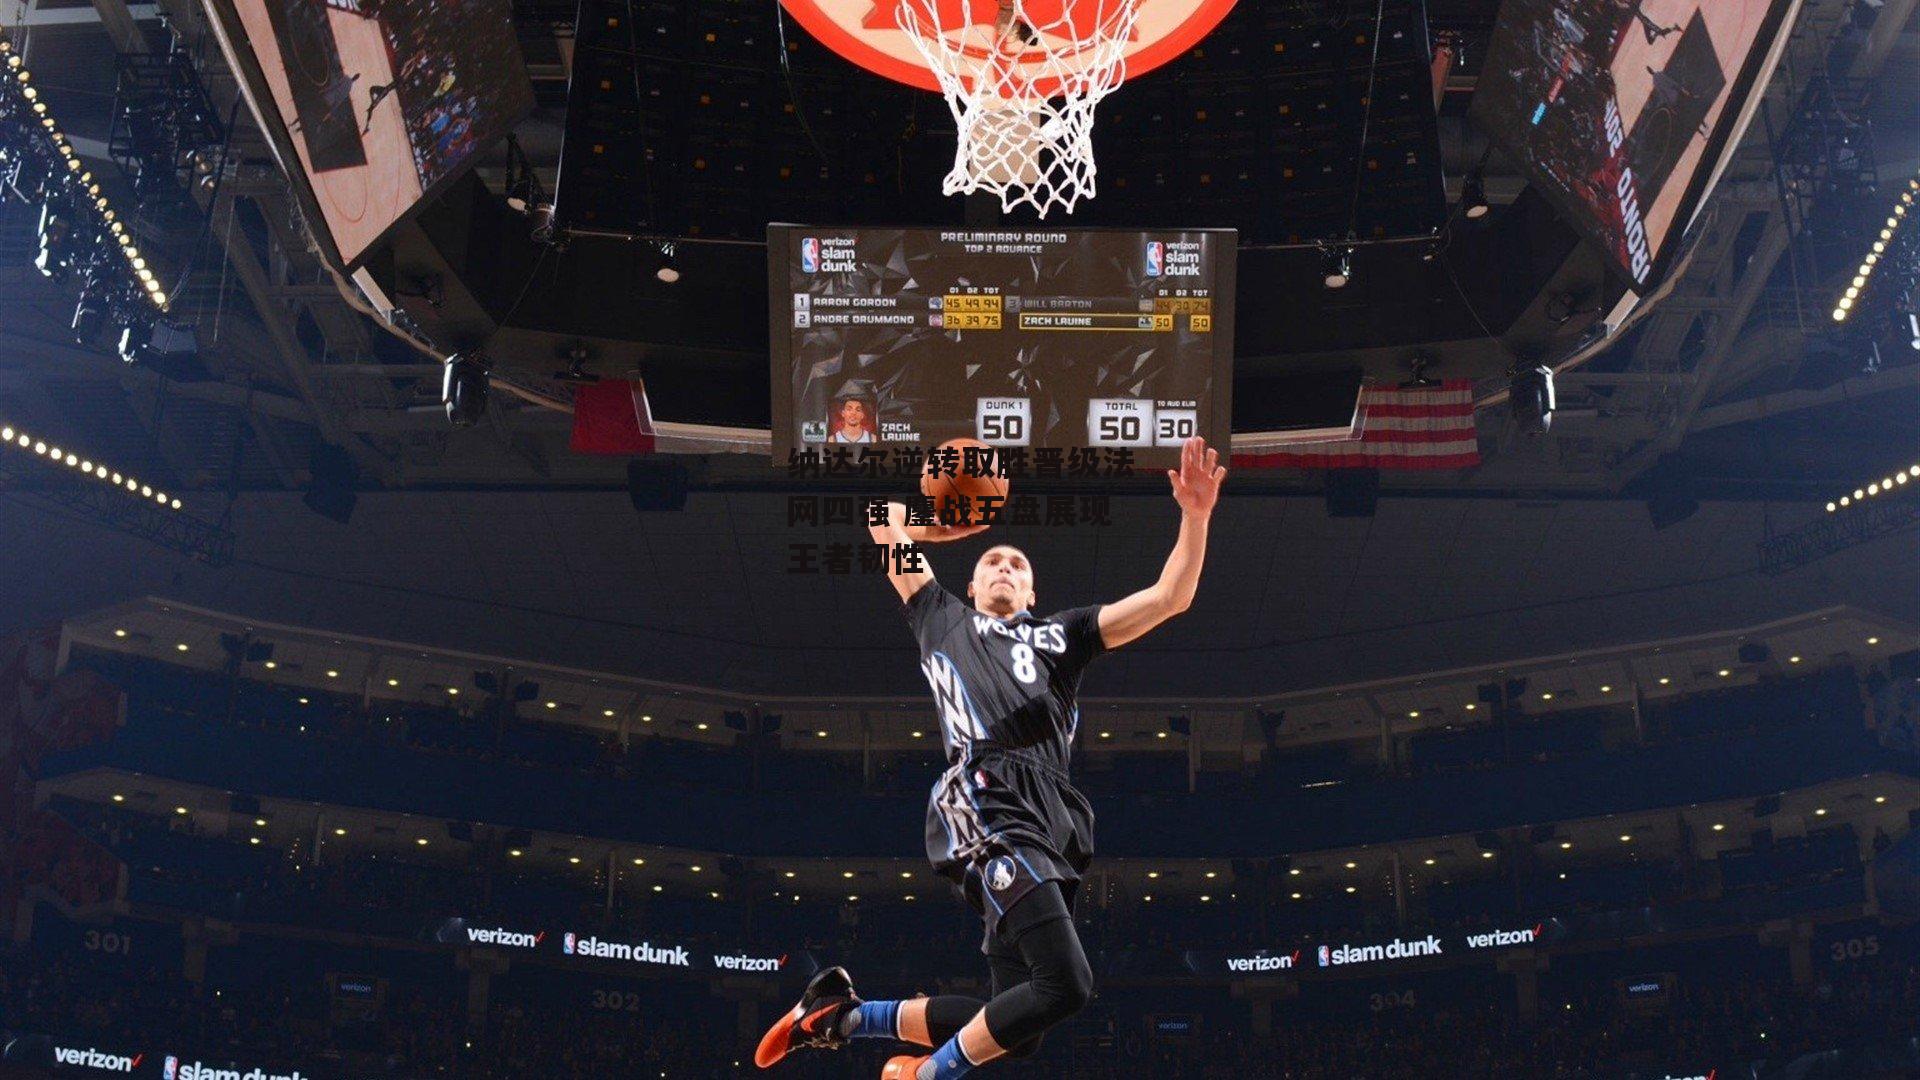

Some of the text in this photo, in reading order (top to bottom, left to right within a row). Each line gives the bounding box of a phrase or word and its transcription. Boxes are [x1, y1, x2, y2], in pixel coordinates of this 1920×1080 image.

[821, 237, 856, 246] verizon
[940, 232, 1068, 243] PRELIMINARY ROUND
[964, 244, 984, 253] TOP
[986, 245, 993, 253] 2
[1165, 241, 1199, 250] verizon
[821, 246, 856, 260] slam
[1165, 250, 1200, 263] slam
[821, 259, 857, 272] dunk
[1165, 263, 1200, 276] dunk
[799, 297, 897, 307] 1 AARON GORDON
[946, 299, 999, 308] 45 49 94
[1024, 299, 1047, 309] WILL
[799, 314, 915, 325] 2 ANDRE DRUMMOND
[965, 315, 980, 325] 39
[983, 315, 998, 326] 75
[1024, 316, 1052, 326] ZACH
[1156, 317, 1170, 327] 50
[1192, 318, 1208, 328] 50
[985, 401, 1023, 410] DUNK 1
[1106, 402, 1138, 411] TOTAL
[881, 423, 911, 432] ZACH
[983, 415, 1023, 440] 50
[1100, 416, 1140, 441] 50
[1159, 418, 1193, 439] 30
[973, 615, 1067, 653] WOLVES
[1011, 642, 1037, 684] 8
[467, 926, 536, 949] verizon
[1466, 928, 1533, 949] verizon
[577, 937, 690, 967] slam dunk
[1331, 935, 1442, 965] slam dunk
[1830, 935, 1879, 961] 305
[714, 953, 779, 972] verizon
[1227, 955, 1291, 972] verizon
[341, 982, 371, 992] verizon
[1629, 982, 1660, 992] verizon
[55, 1046, 131, 1073] verizon
